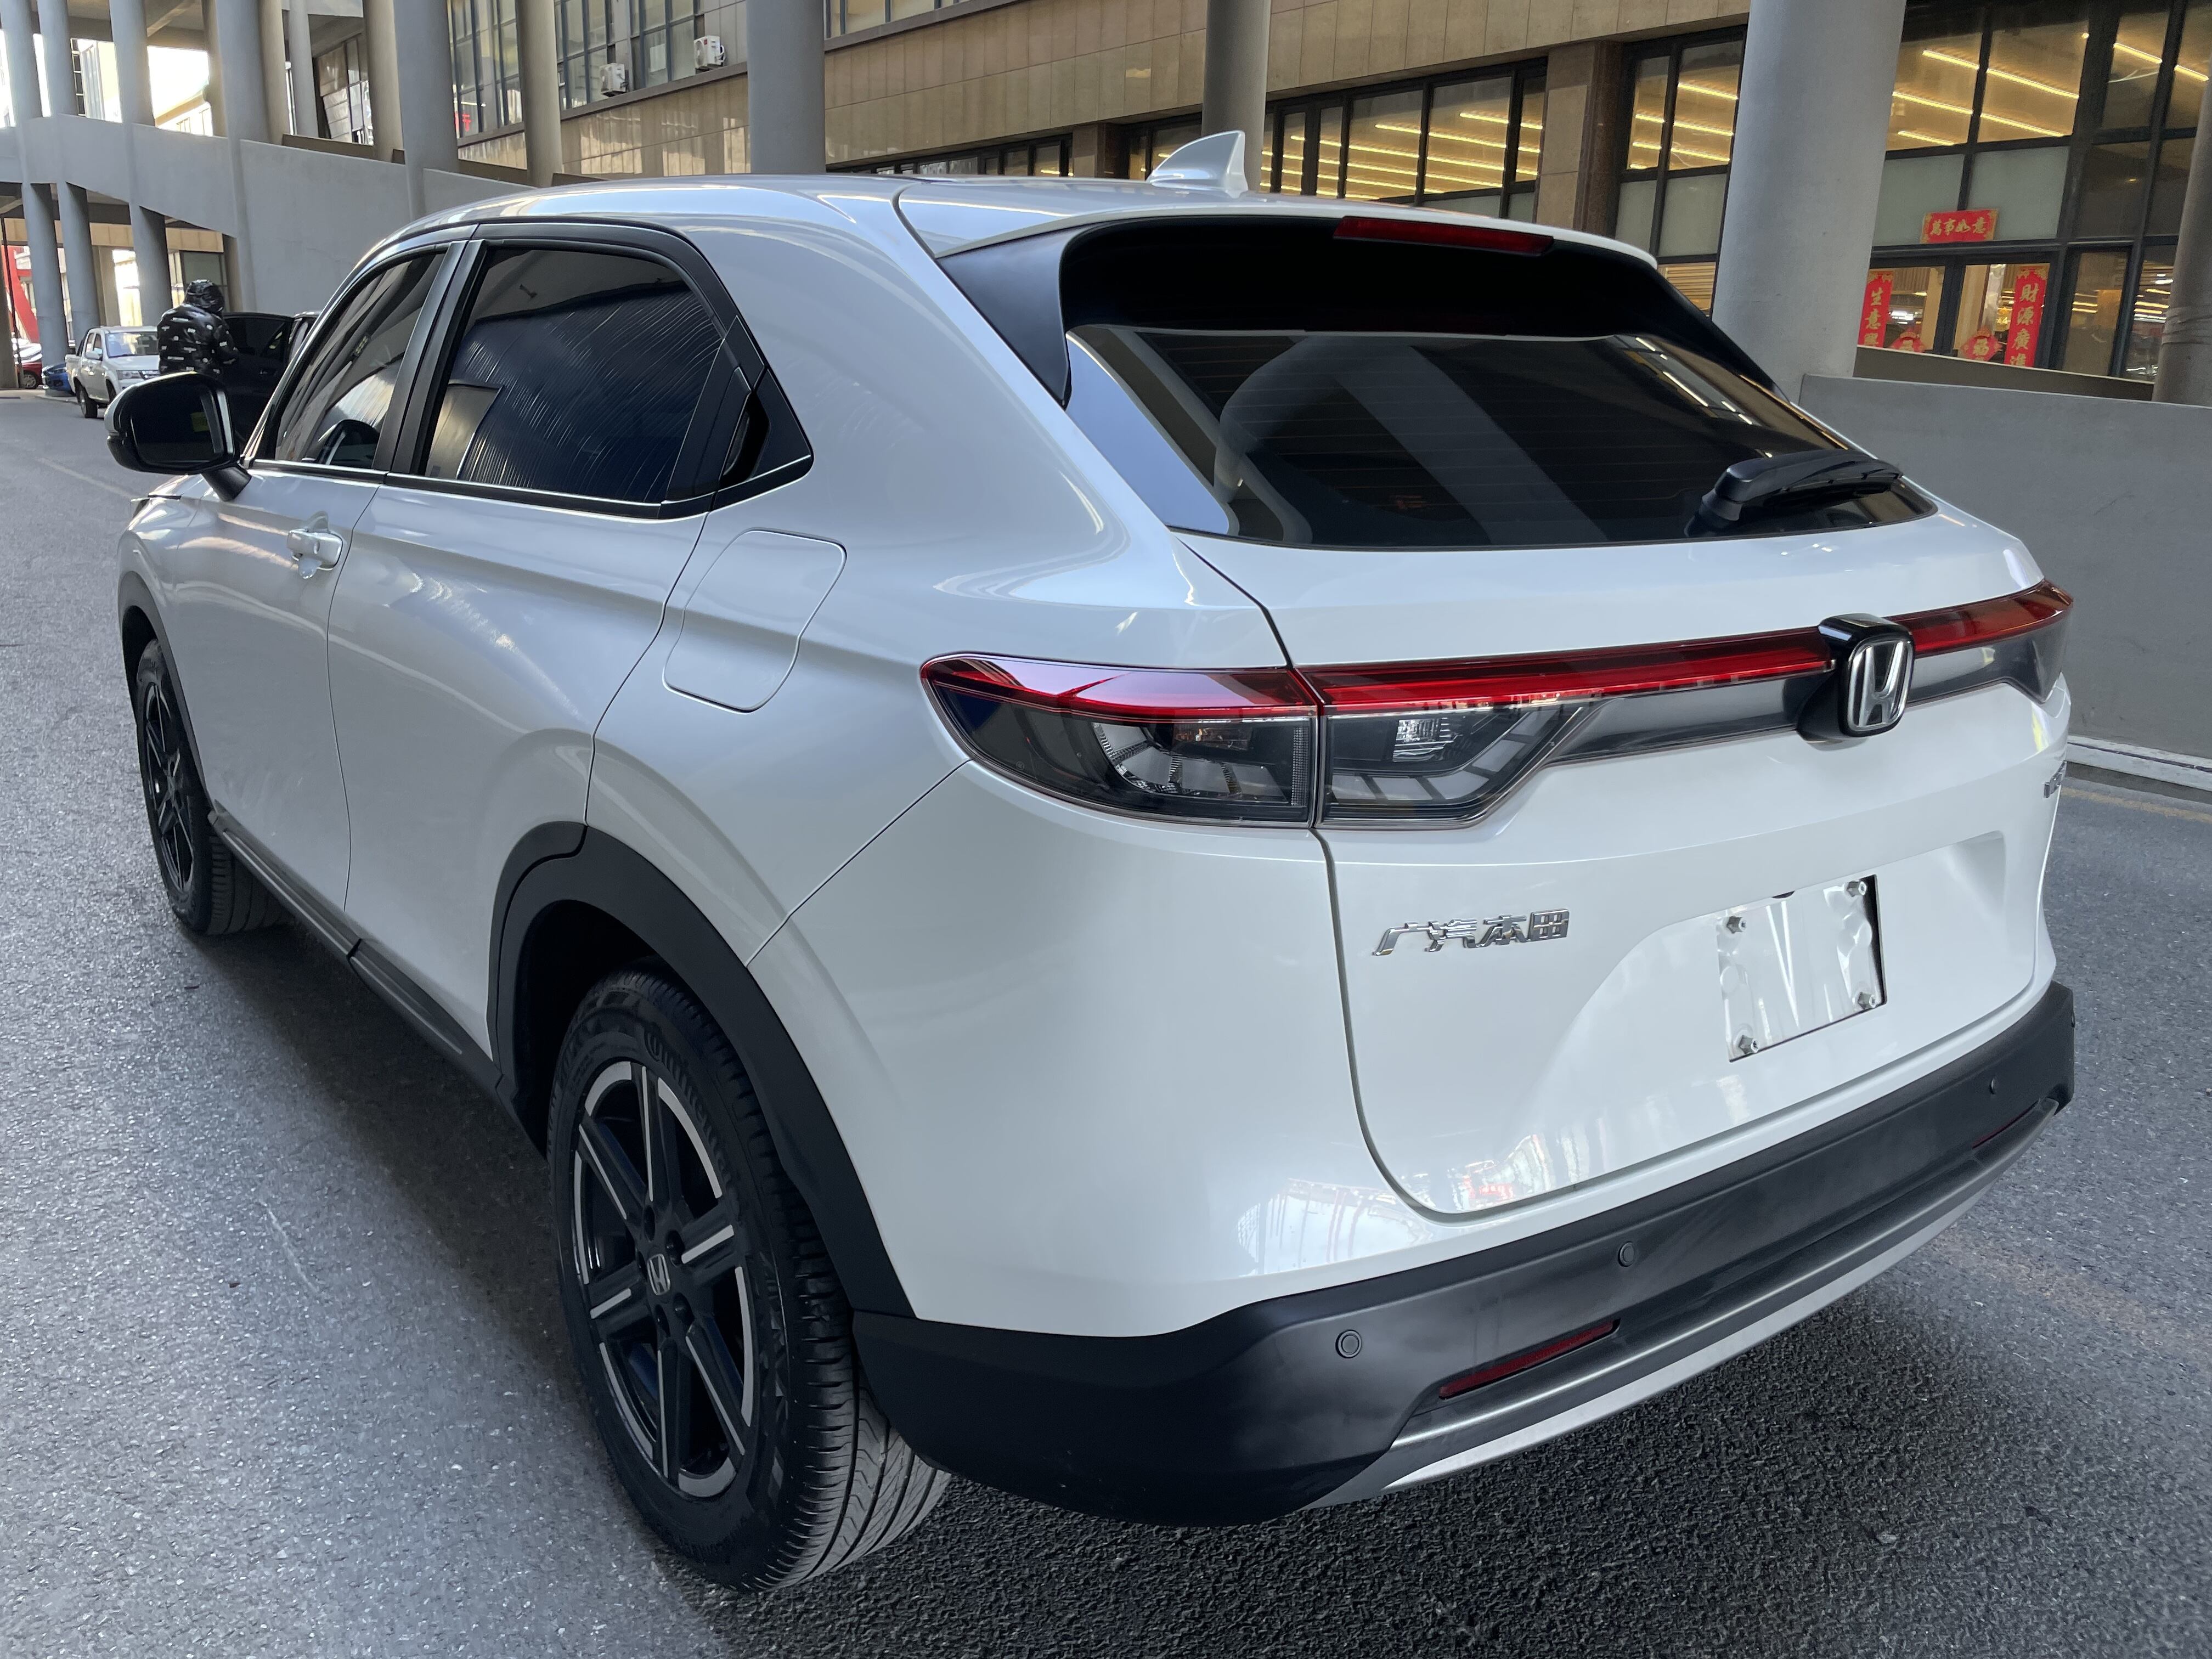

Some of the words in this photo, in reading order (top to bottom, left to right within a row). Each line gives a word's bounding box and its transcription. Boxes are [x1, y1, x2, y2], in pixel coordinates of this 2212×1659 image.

[1930, 216, 1988, 236] 萬事如意
[1372, 908, 1570, 956] 广汽本田
